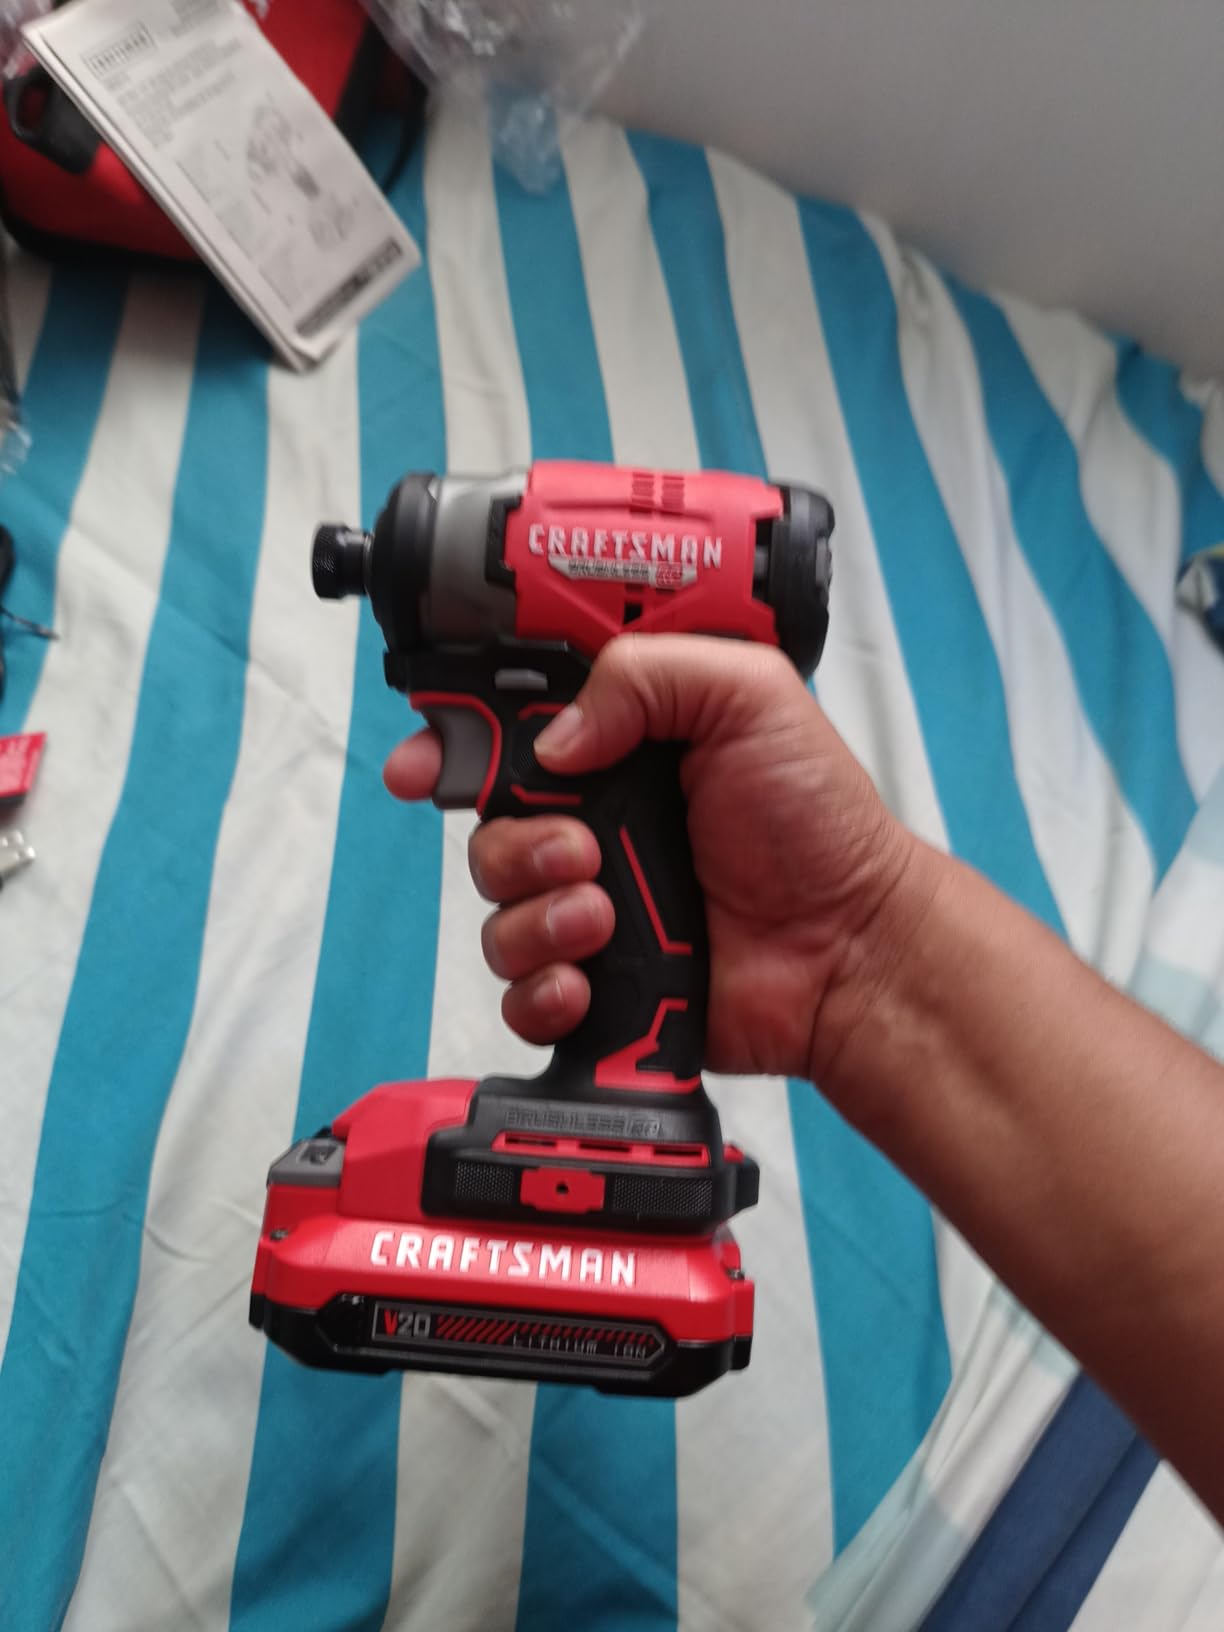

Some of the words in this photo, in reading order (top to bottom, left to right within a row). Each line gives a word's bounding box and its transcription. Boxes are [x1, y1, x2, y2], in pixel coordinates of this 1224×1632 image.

[528, 523, 723, 570] CRAFTSMAN
[370, 1230, 636, 1288] CRAFTSMAN
[384, 1308, 432, 1338] V20
